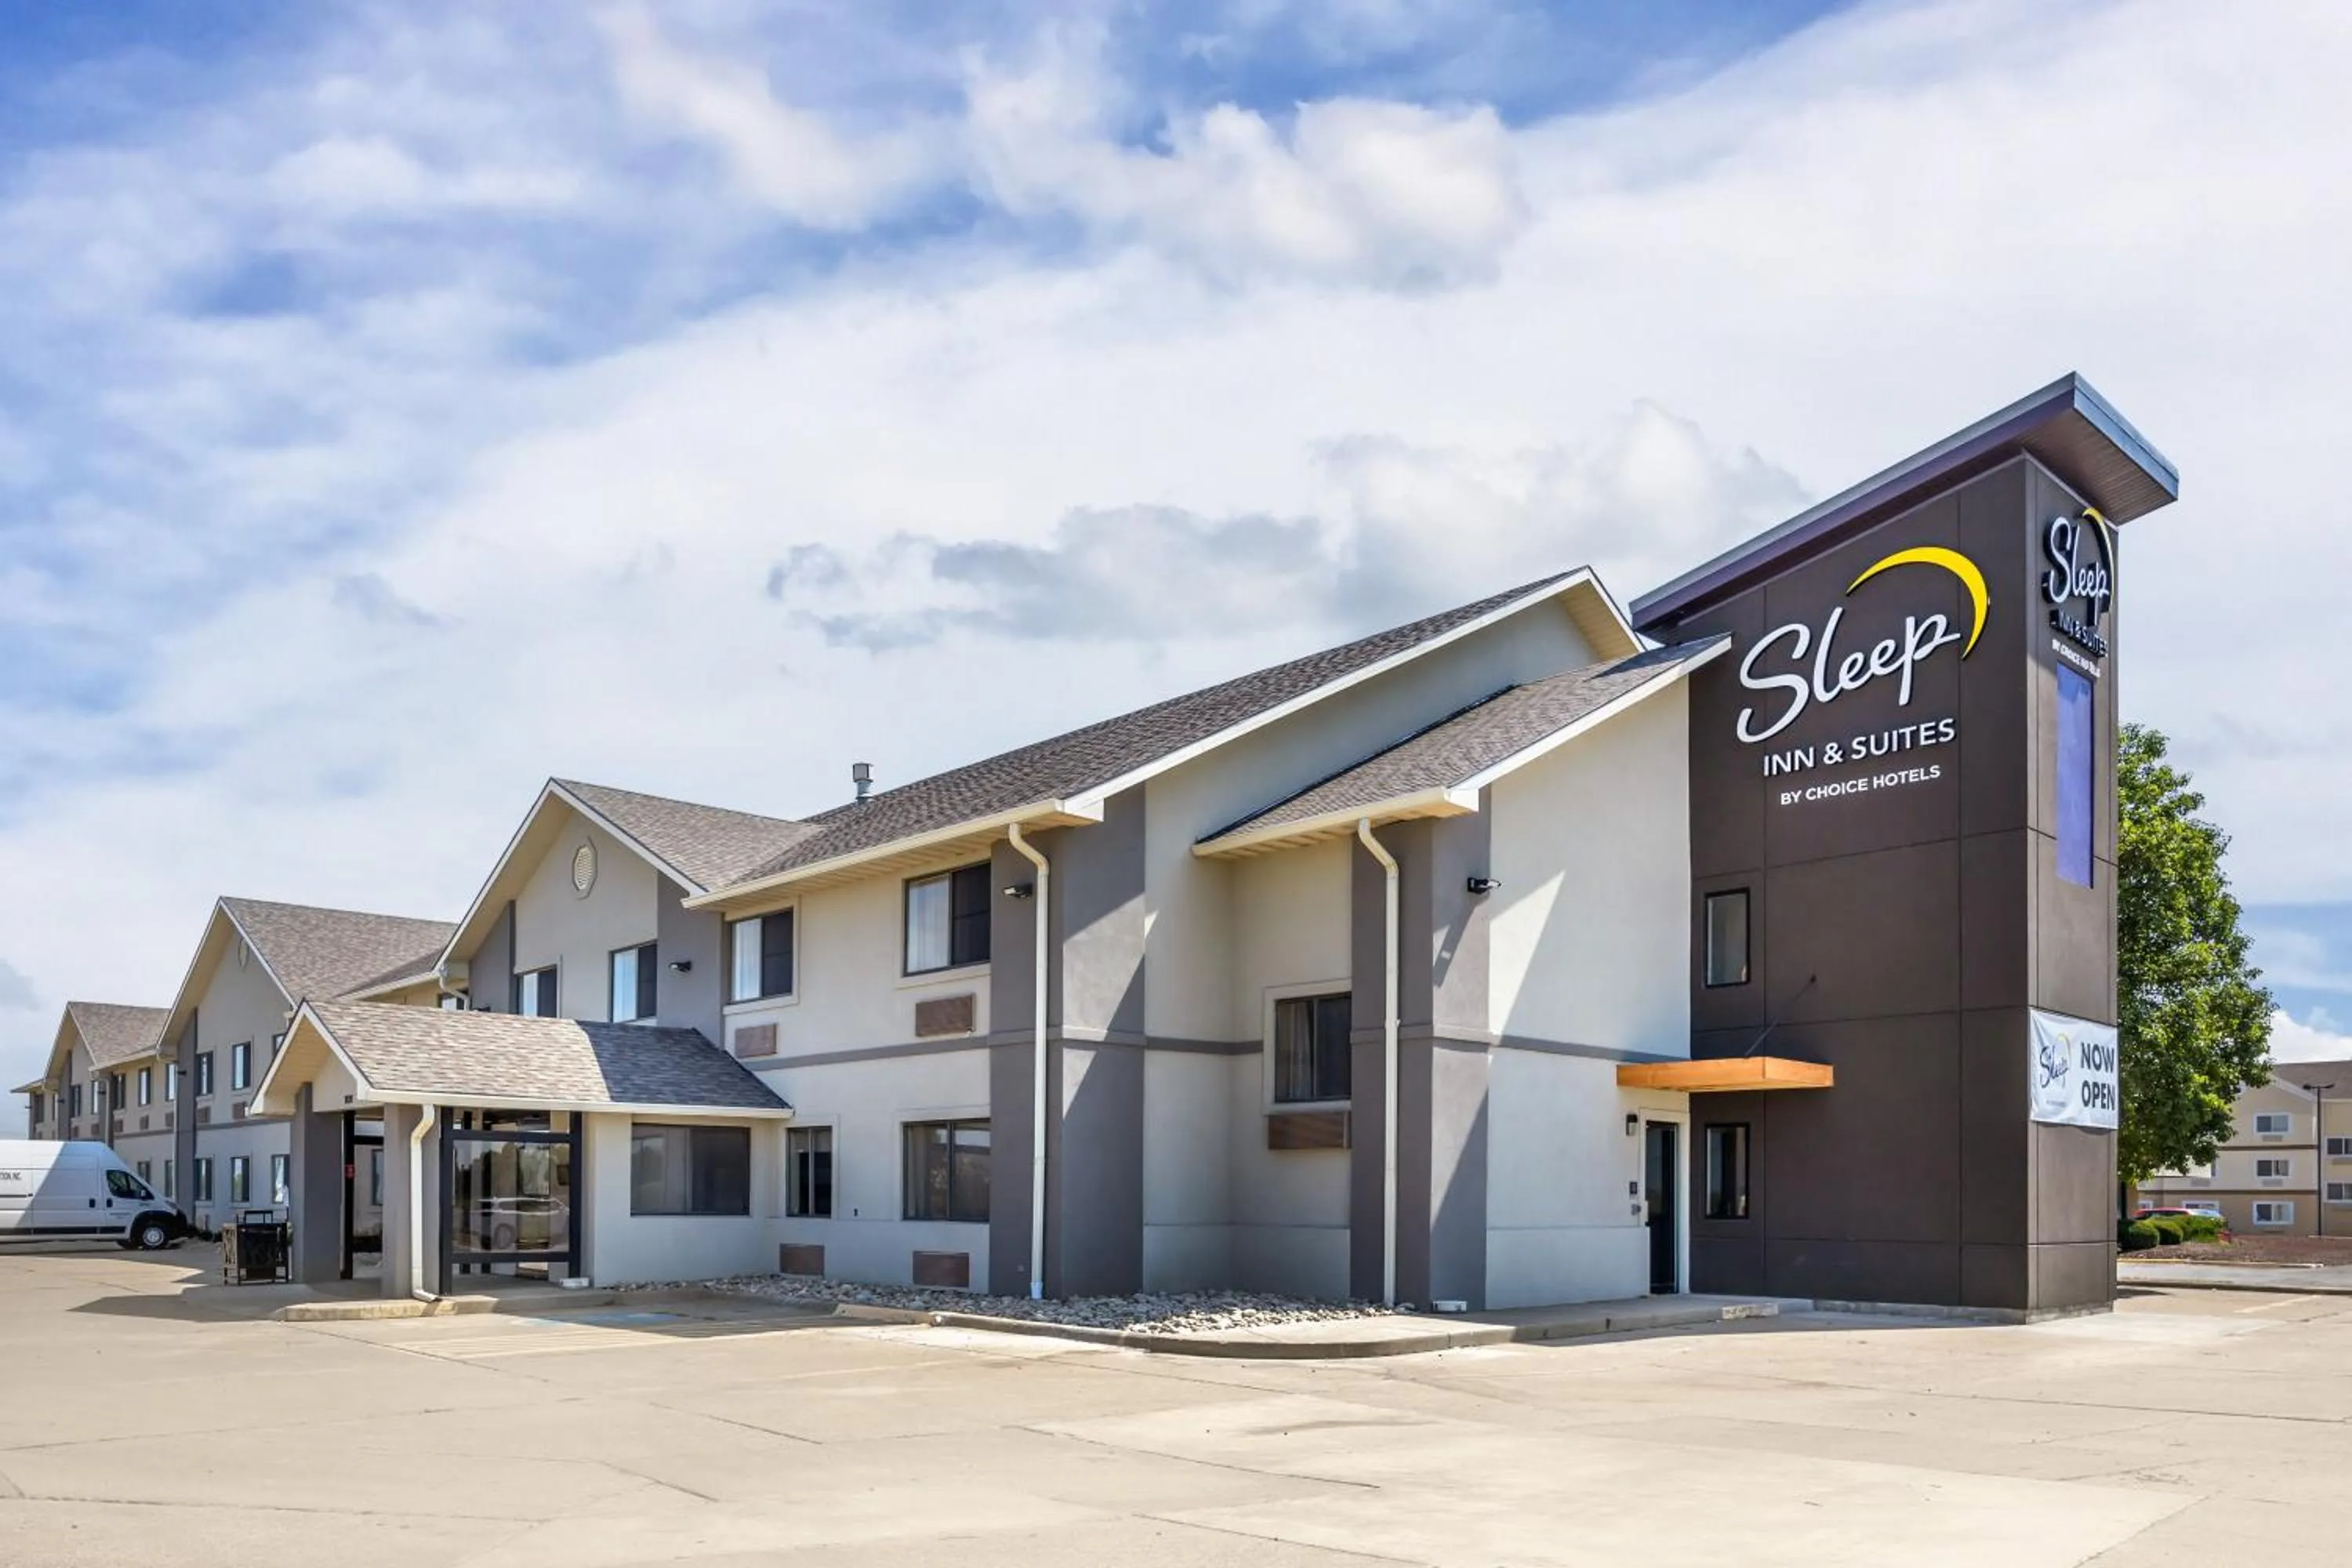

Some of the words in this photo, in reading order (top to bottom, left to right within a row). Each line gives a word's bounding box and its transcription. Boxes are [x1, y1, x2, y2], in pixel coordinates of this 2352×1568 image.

[2049, 517, 2110, 626] Sleep
[1737, 606, 1961, 743] Sleep
[1763, 746, 1815, 776] INN
[1823, 742, 1843, 765] &
[1851, 718, 1955, 759] SUITES
[1780, 791, 1802, 806] BY
[1806, 778, 1868, 800] CHOICE
[1873, 765, 1940, 789] HOTELS
[2081, 1041, 2114, 1073] NOW
[2082, 1080, 2115, 1111] OPEN
